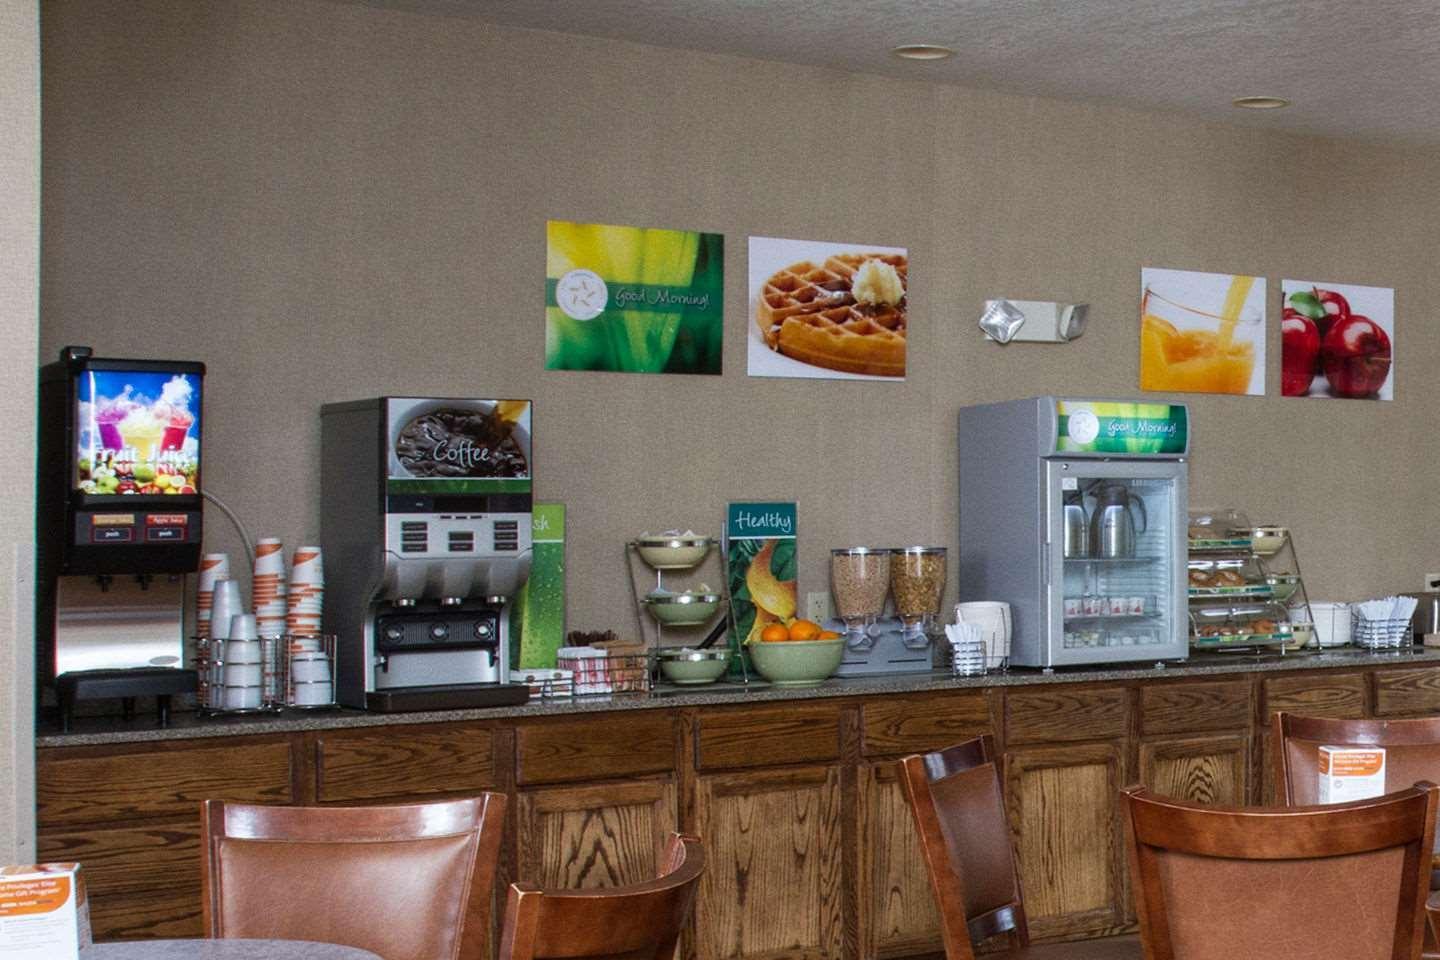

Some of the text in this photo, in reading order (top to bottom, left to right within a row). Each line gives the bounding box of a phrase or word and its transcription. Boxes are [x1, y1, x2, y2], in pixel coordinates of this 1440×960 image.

[615, 287, 646, 308] Good
[1107, 419, 1129, 437] Good
[432, 439, 490, 468] Coffee
[735, 510, 792, 533] Healthy
